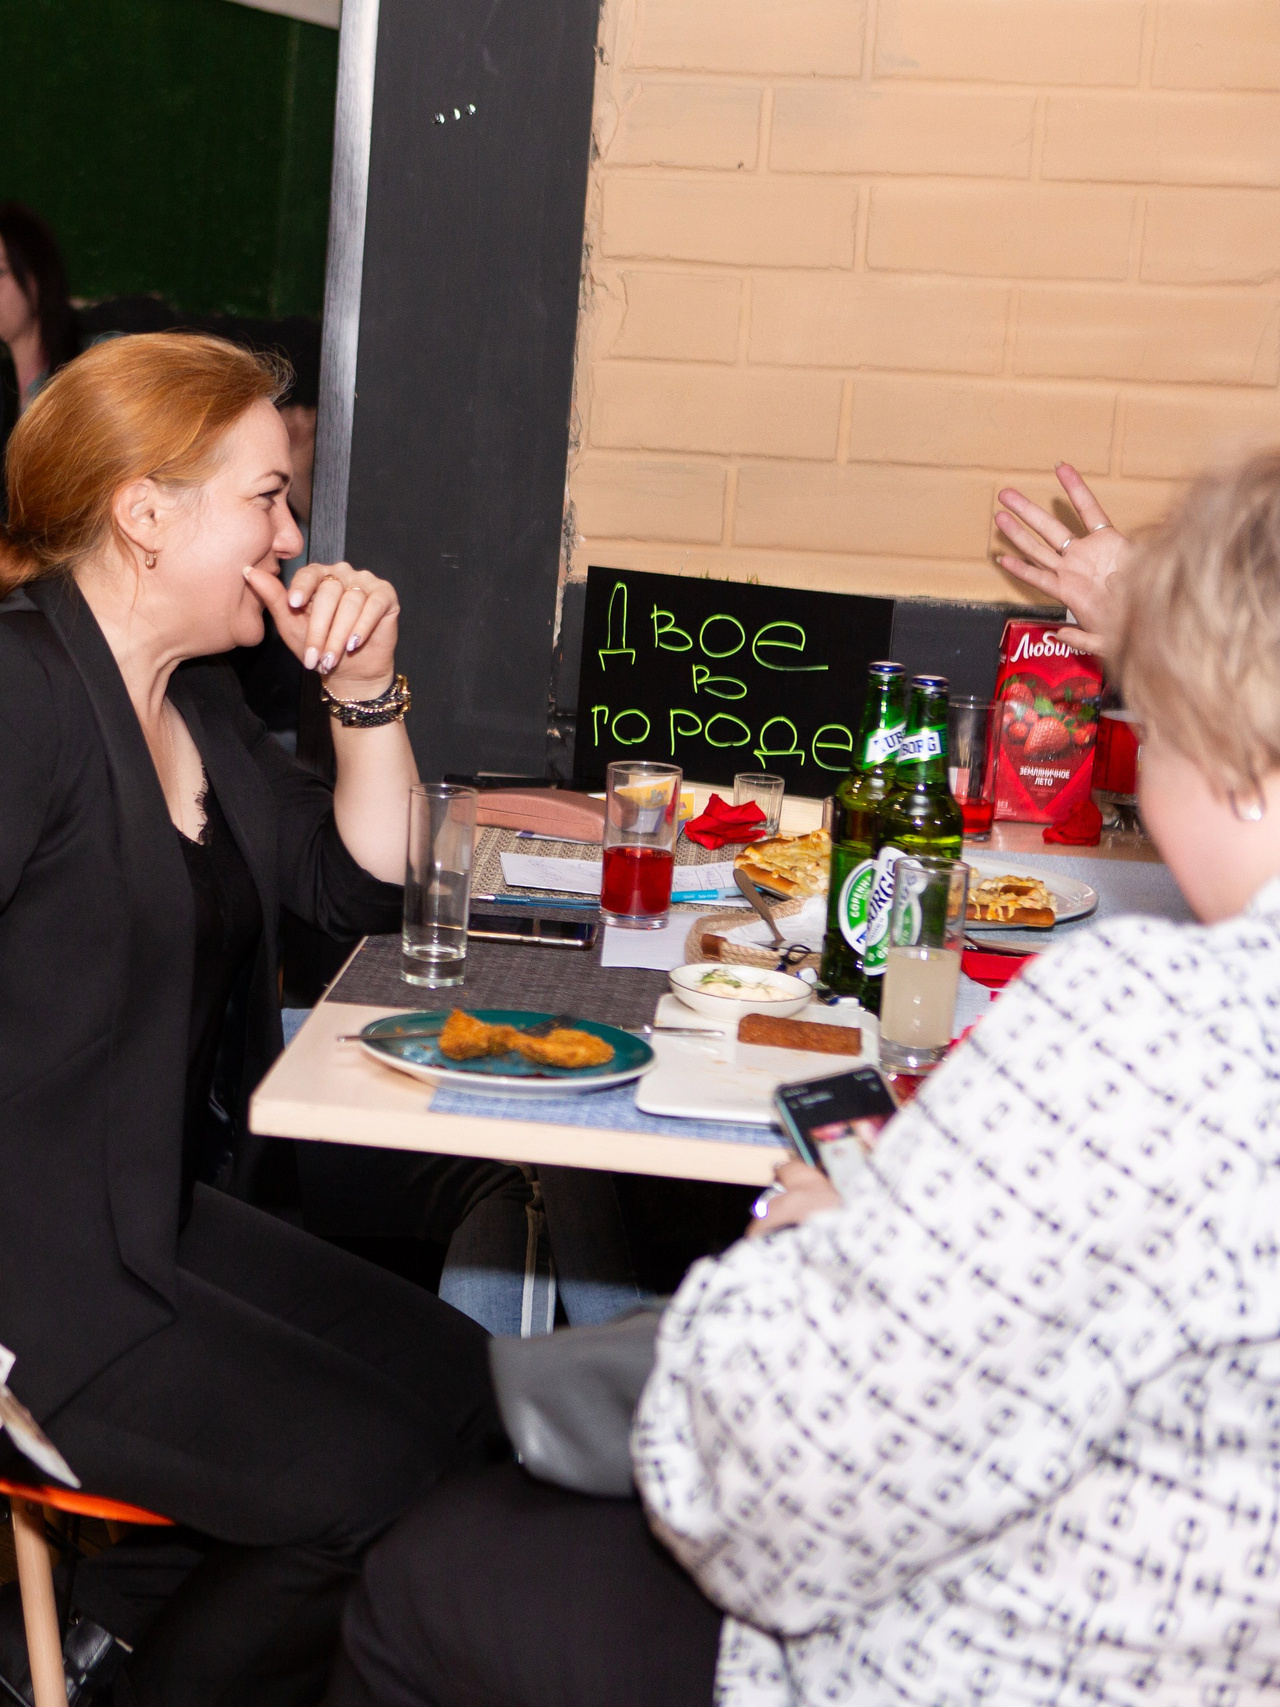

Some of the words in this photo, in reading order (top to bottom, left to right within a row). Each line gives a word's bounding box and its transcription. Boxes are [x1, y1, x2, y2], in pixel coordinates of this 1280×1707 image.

[1009, 630, 1092, 663] Любим
[1019, 765, 1070, 779] ЗЕМЛЯНИЧНОЕ
[1034, 777, 1054, 787] ЛЕТО
